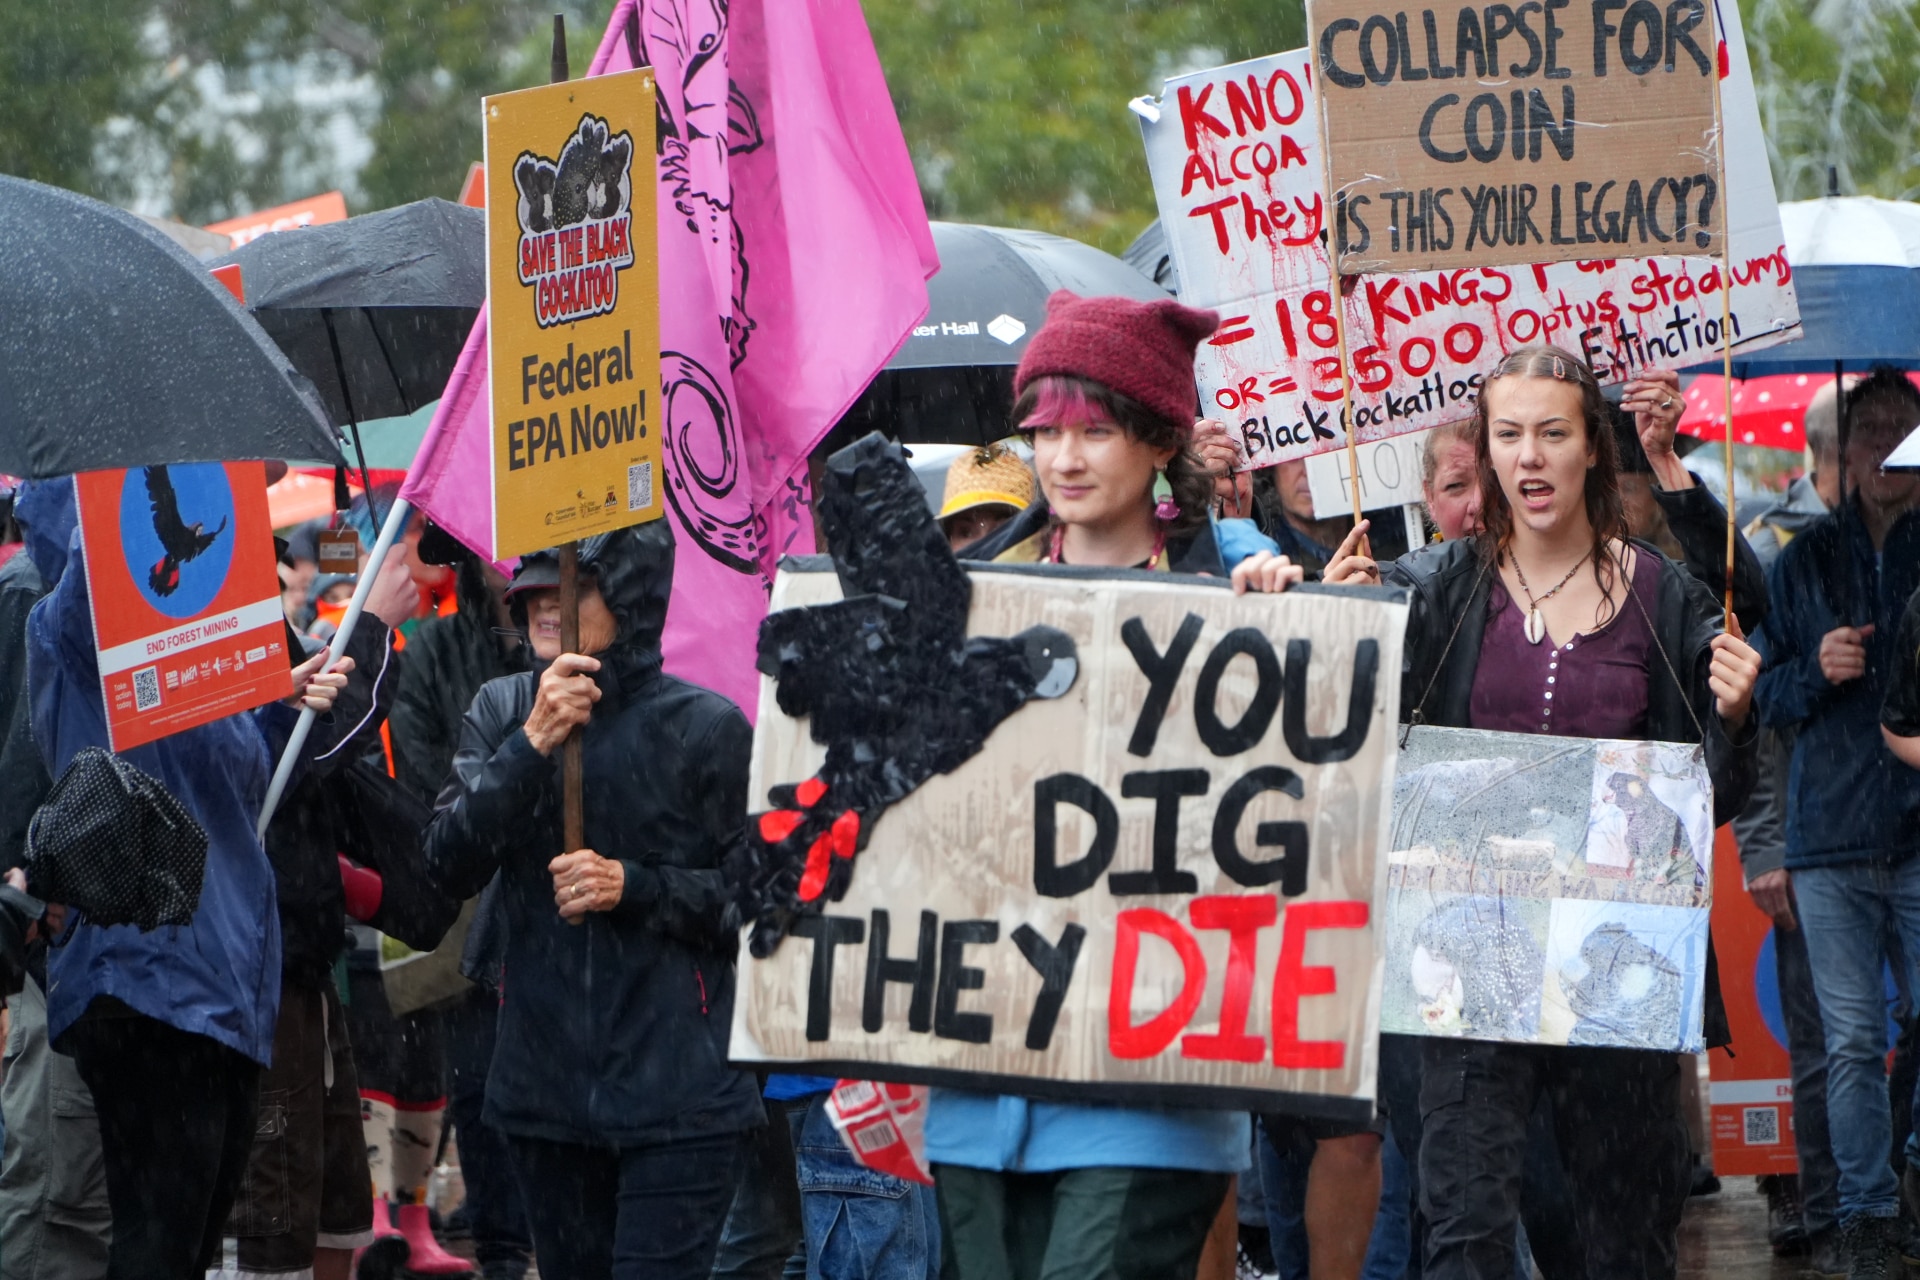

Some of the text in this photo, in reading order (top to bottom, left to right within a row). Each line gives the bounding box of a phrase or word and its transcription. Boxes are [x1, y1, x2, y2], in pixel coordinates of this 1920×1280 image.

[1319, 0, 1712, 89] COLLAPSE FOR
[1177, 62, 1312, 151] KNO
[1418, 85, 1575, 163] COIN
[1181, 134, 1308, 198] ALCOA
[521, 217, 629, 278] SAVE THE BLACK
[1187, 191, 1323, 256] They
[1336, 173, 1717, 256] IS THIS YOUR LEGACY?
[539, 263, 614, 321] COCKATOO
[1275, 290, 1339, 358] 18
[941, 321, 979, 336] Hall
[1311, 322, 1484, 402] 3500
[522, 329, 634, 405] Federal
[508, 412, 566, 472] EPA
[1241, 401, 1336, 459] Black
[146, 616, 239, 655] END FOREST MINING
[1120, 611, 1378, 764] YOU
[1033, 766, 1309, 898] DIG
[791, 893, 1370, 1069] THEY DIE
